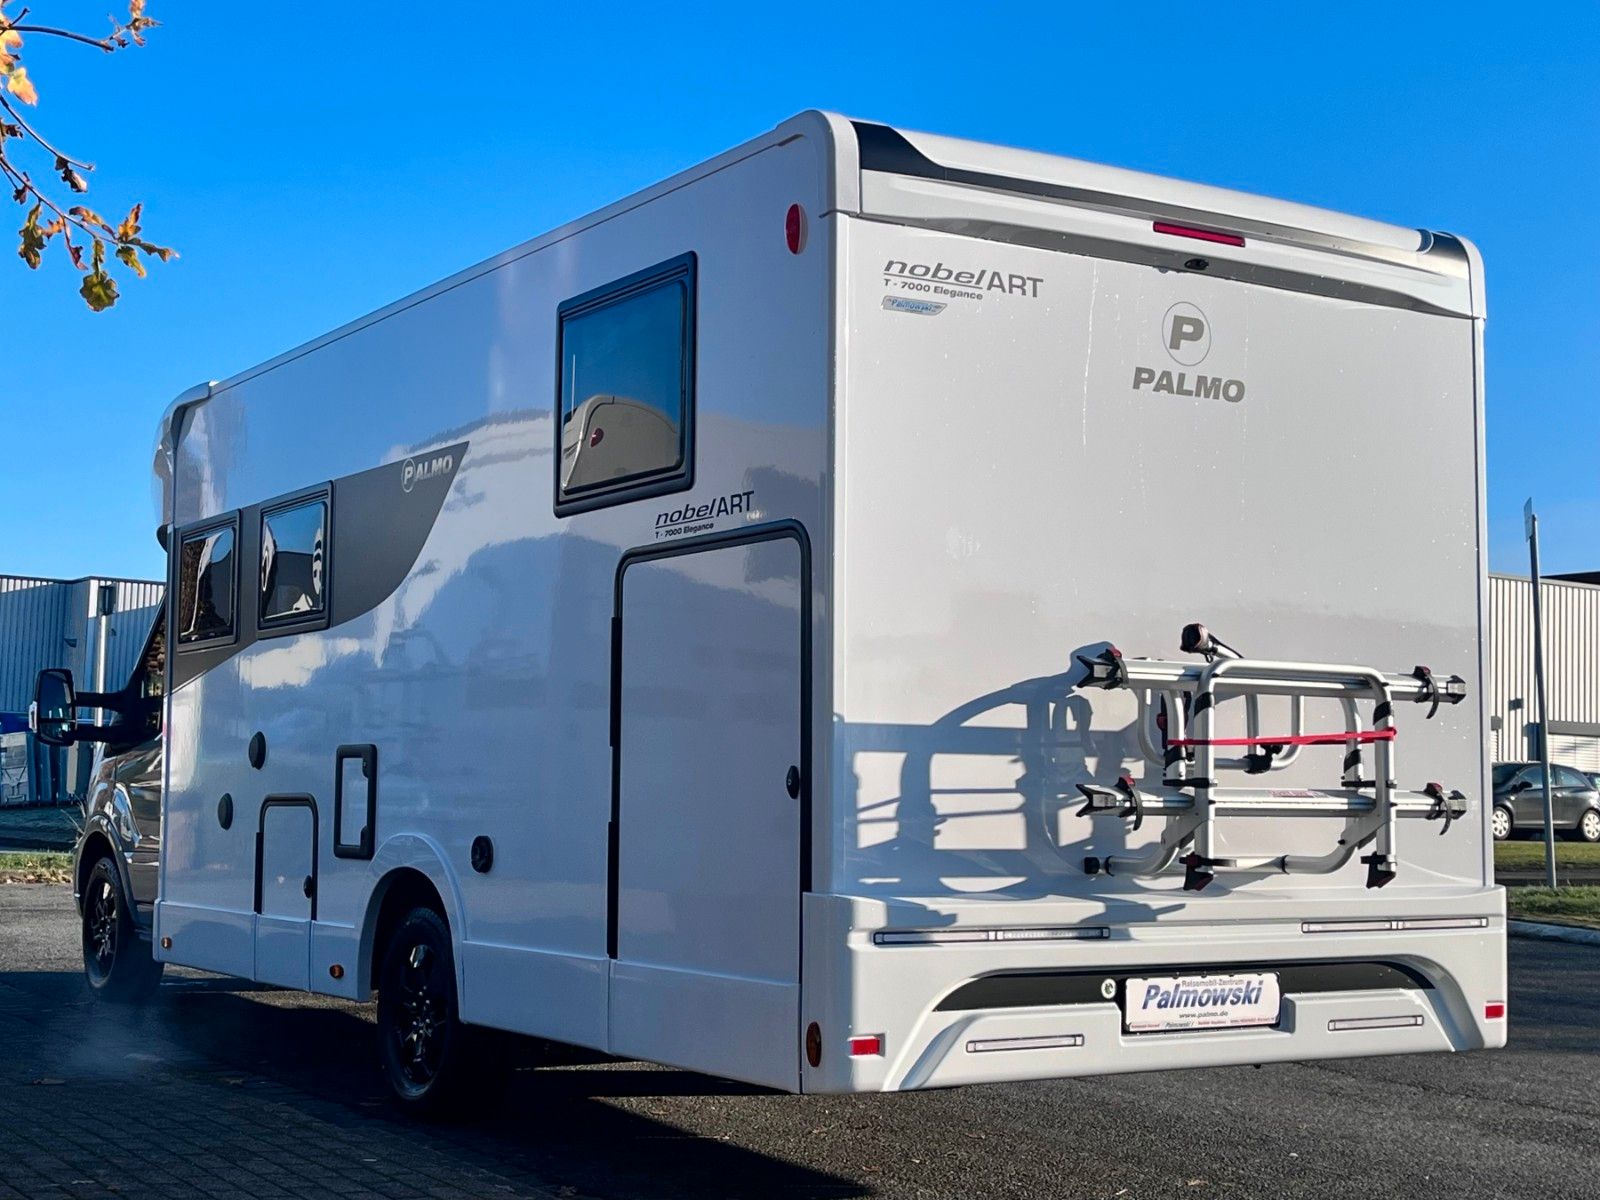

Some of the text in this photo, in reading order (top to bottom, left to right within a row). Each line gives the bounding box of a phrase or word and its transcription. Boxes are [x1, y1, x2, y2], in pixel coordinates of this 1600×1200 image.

[884, 260, 1044, 298] nobelART
[884, 278, 890, 287] T
[901, 281, 930, 293] 7000
[933, 286, 983, 300] Elegance
[1132, 366, 1245, 403] PALMO
[403, 455, 453, 486] PALMO
[655, 490, 755, 526] nobelART
[664, 527, 683, 538] 7000
[683, 522, 714, 534] Elegance
[1142, 980, 1264, 1010] Palmowski
